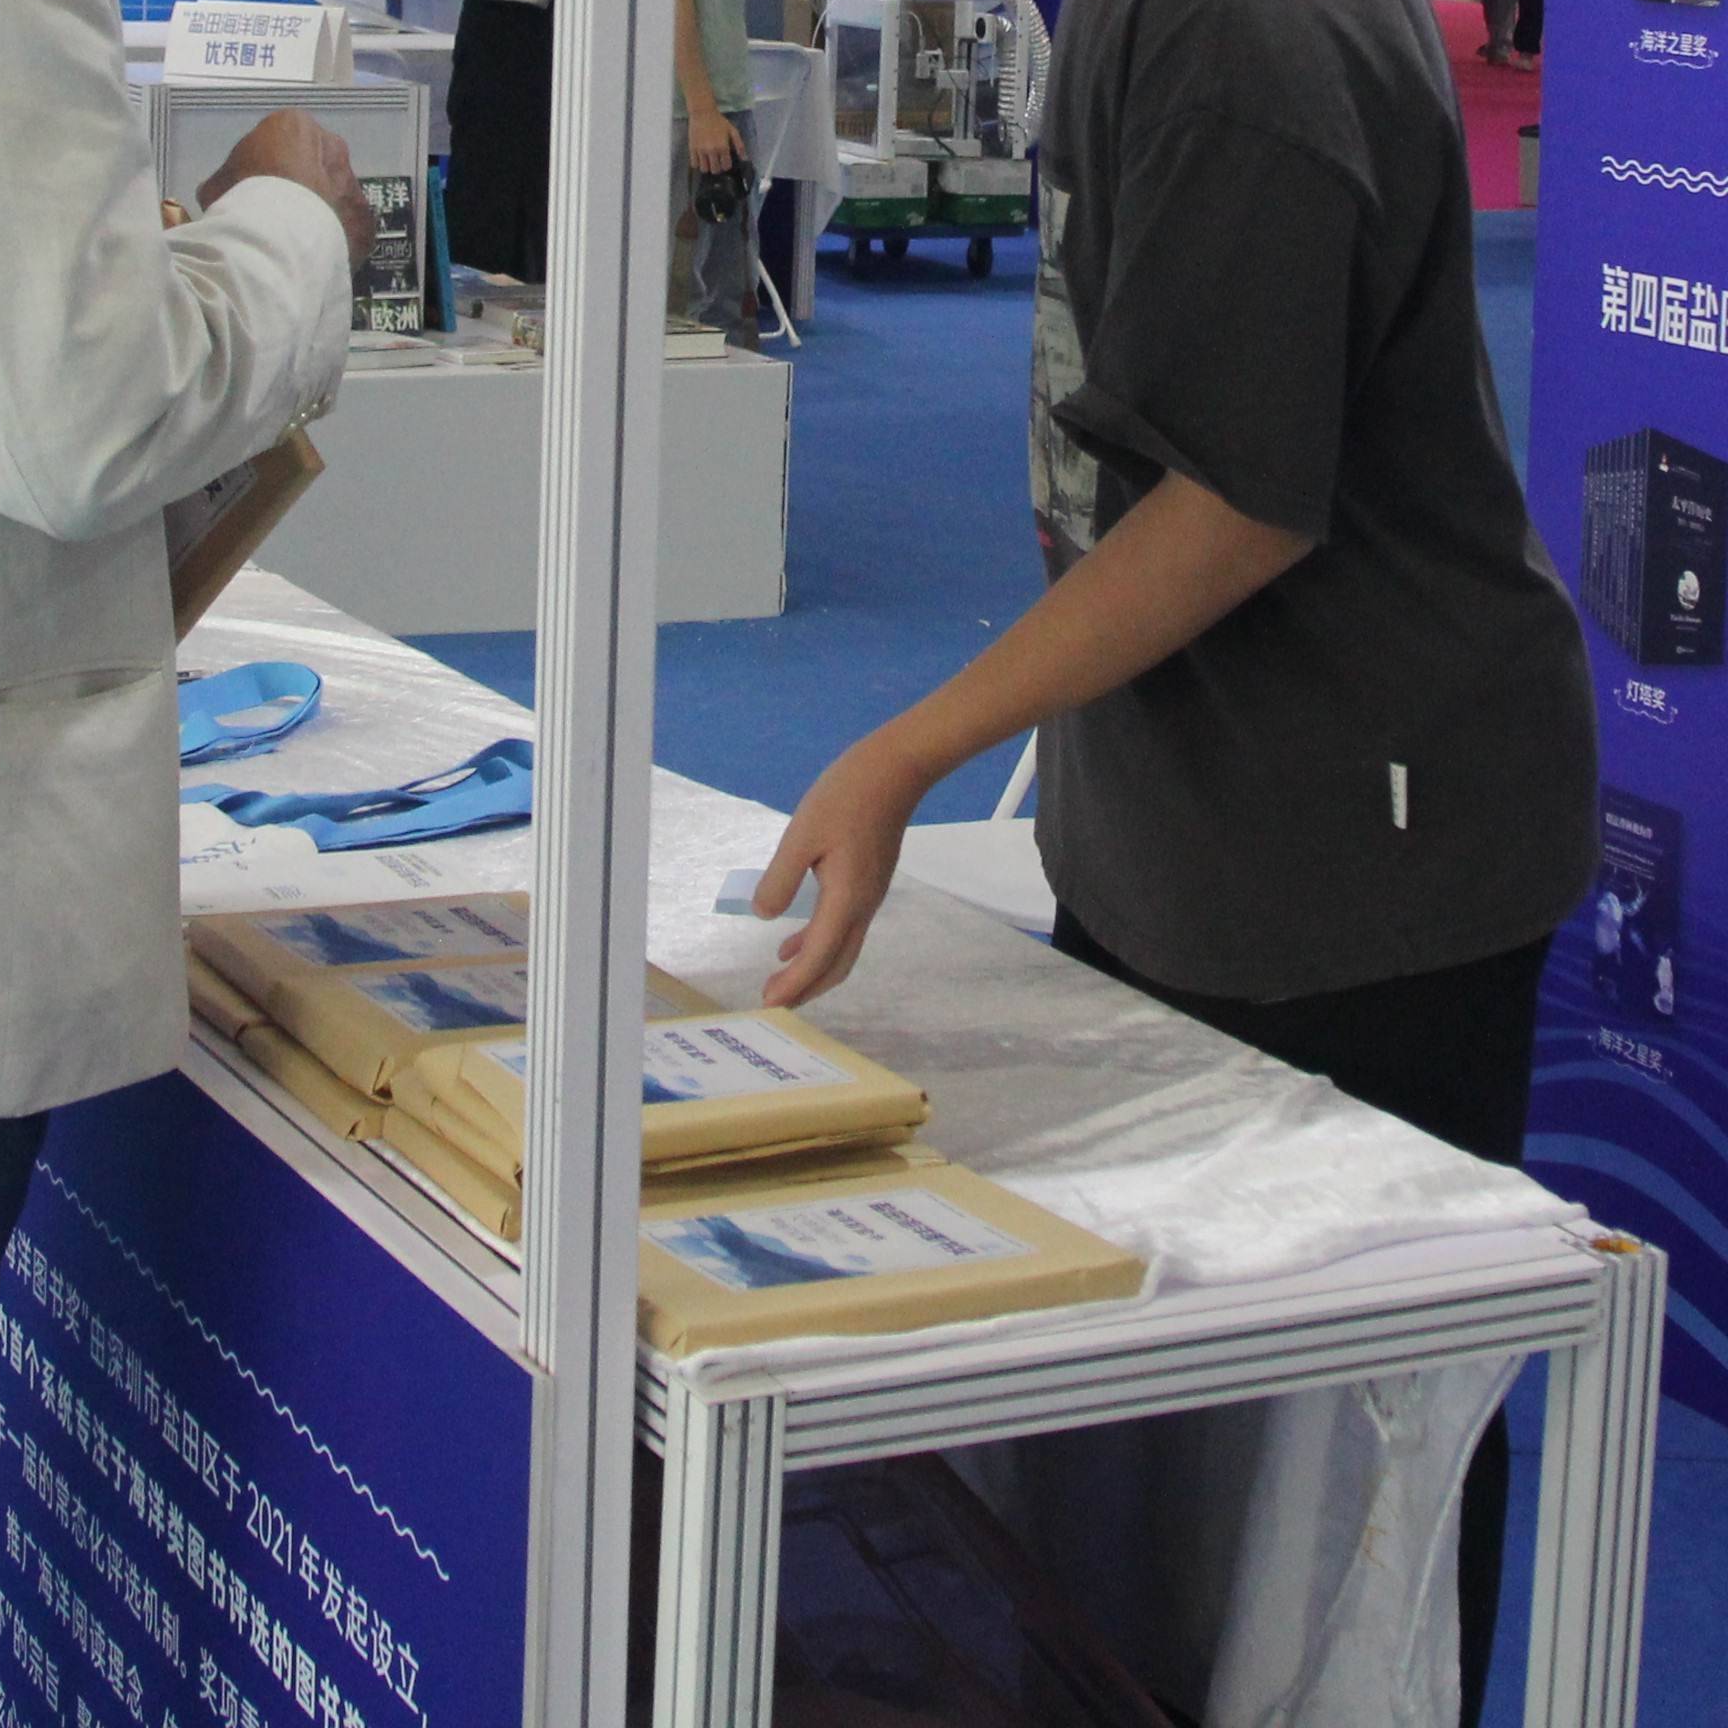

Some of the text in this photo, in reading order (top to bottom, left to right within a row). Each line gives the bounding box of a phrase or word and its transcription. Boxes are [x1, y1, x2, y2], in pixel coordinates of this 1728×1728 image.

[205, 40, 276, 69] 优秀图书
[1640, 29, 1708, 59] 海洋之星奖
[1626, 678, 1666, 712] 灯塔奖
[1598, 1026, 1663, 1074] 海洋之星奖
